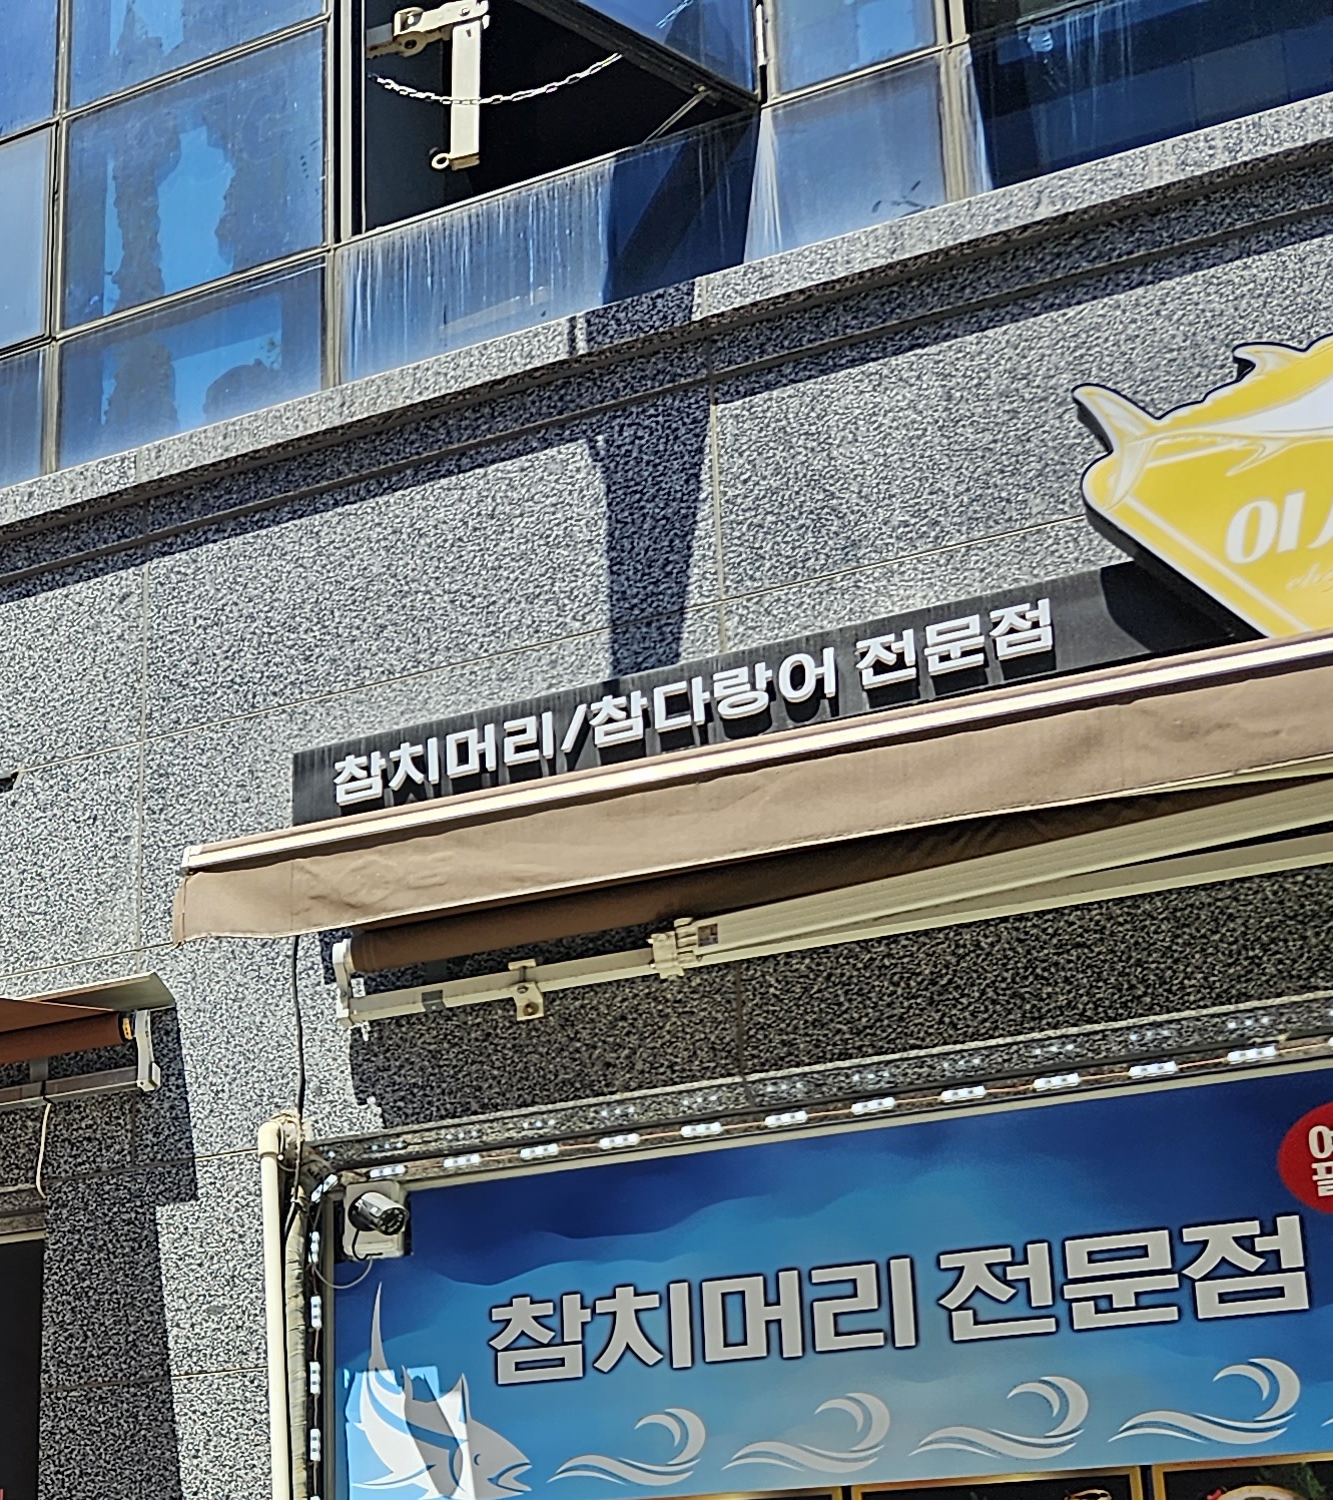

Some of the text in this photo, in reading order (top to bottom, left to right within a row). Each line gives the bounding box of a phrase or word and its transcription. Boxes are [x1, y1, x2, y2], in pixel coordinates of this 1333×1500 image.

[333, 599, 1056, 805] 참치머리/참다랑어 전문점
[487, 1212, 1311, 1386] 참치머리 전문점
